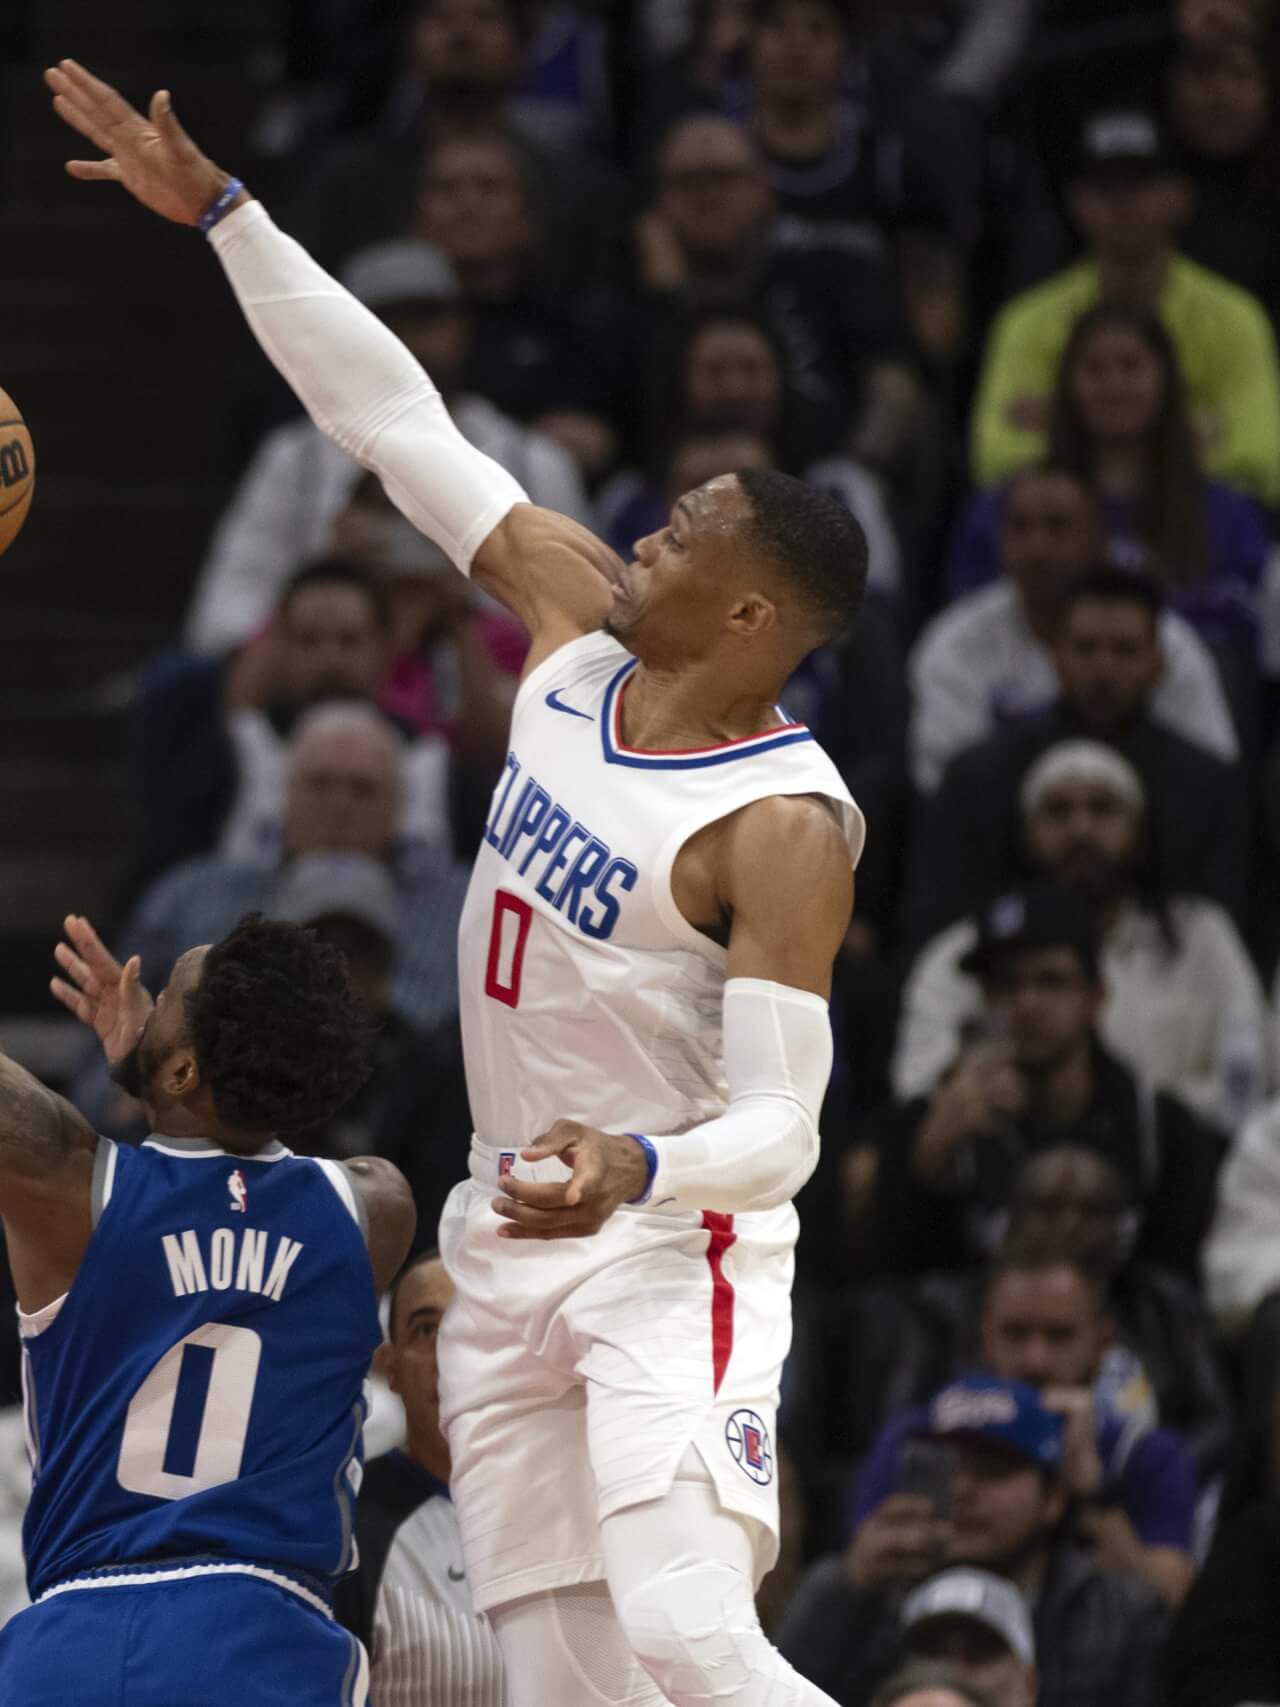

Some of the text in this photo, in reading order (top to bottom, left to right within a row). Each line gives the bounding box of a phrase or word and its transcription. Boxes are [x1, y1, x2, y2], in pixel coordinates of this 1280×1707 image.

[485, 889, 533, 1010] 0
[161, 1228, 305, 1302] MONK
[116, 1321, 264, 1501] 0
